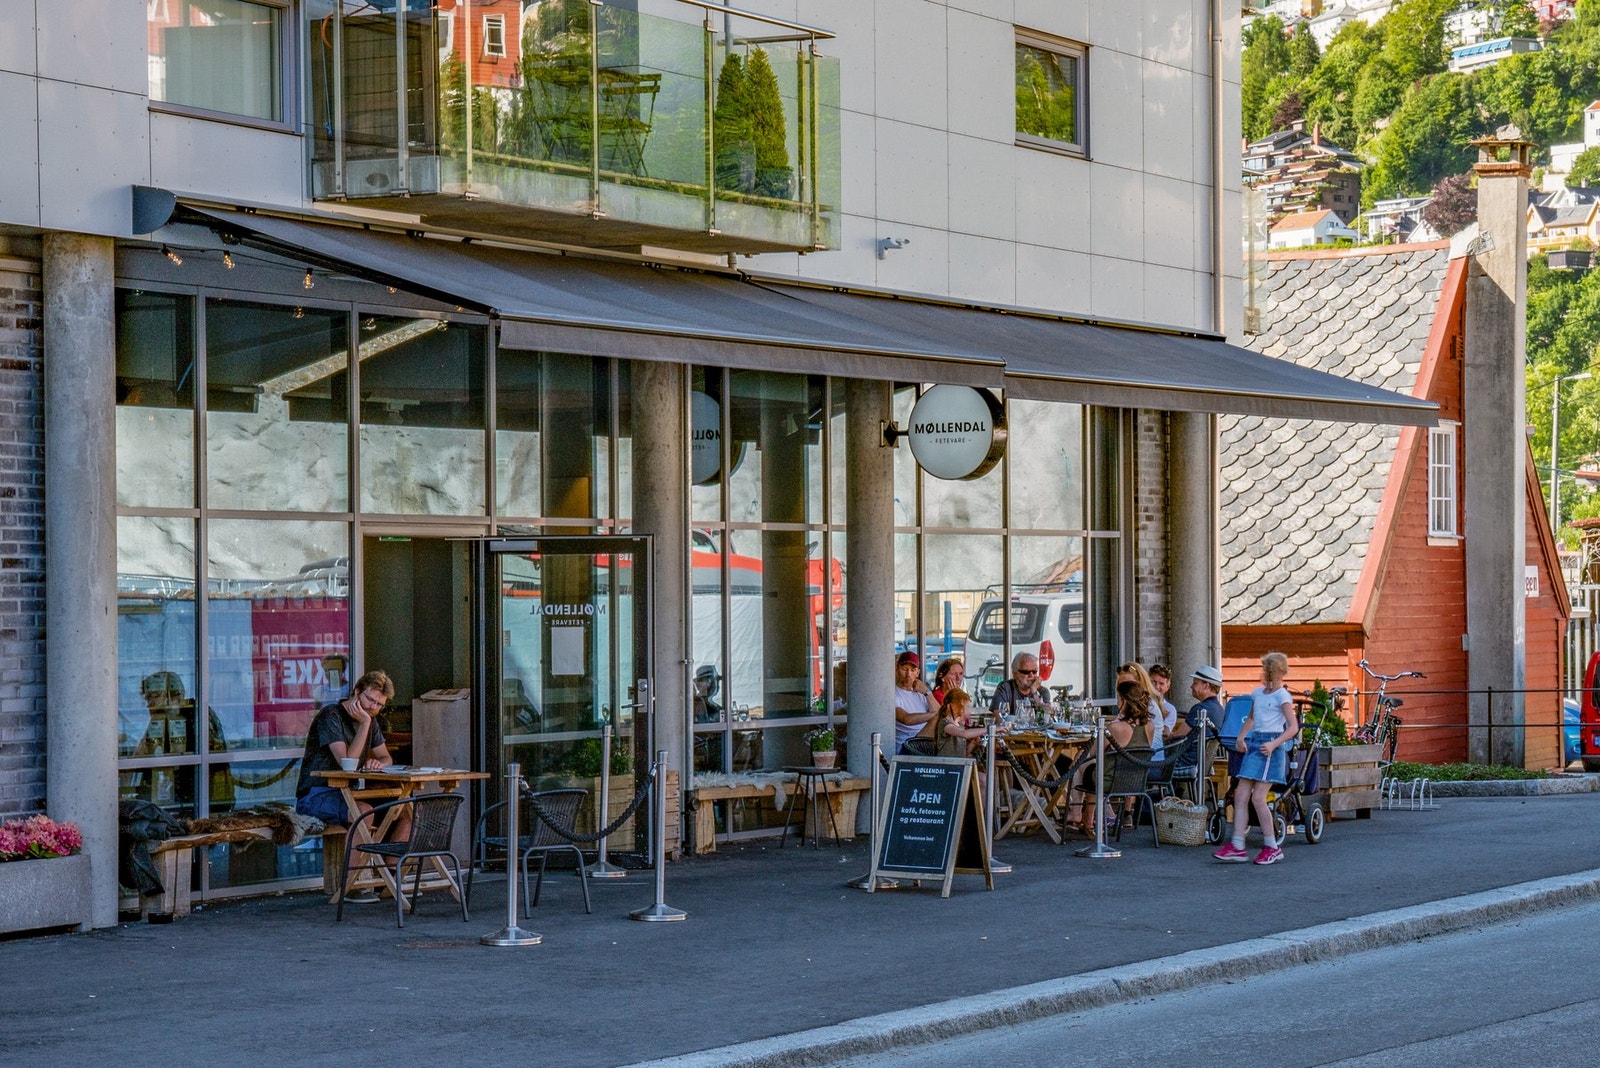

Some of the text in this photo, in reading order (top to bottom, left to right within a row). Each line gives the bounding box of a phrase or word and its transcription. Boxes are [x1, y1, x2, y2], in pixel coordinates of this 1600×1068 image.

[914, 421, 986, 434] MØLLENDAL
[914, 767, 946, 775] MØLLENDAL
[910, 788, 942, 804] ÅPEN
[900, 806, 946, 816] kafé, fetevare
[899, 816, 945, 825] og restaurant
